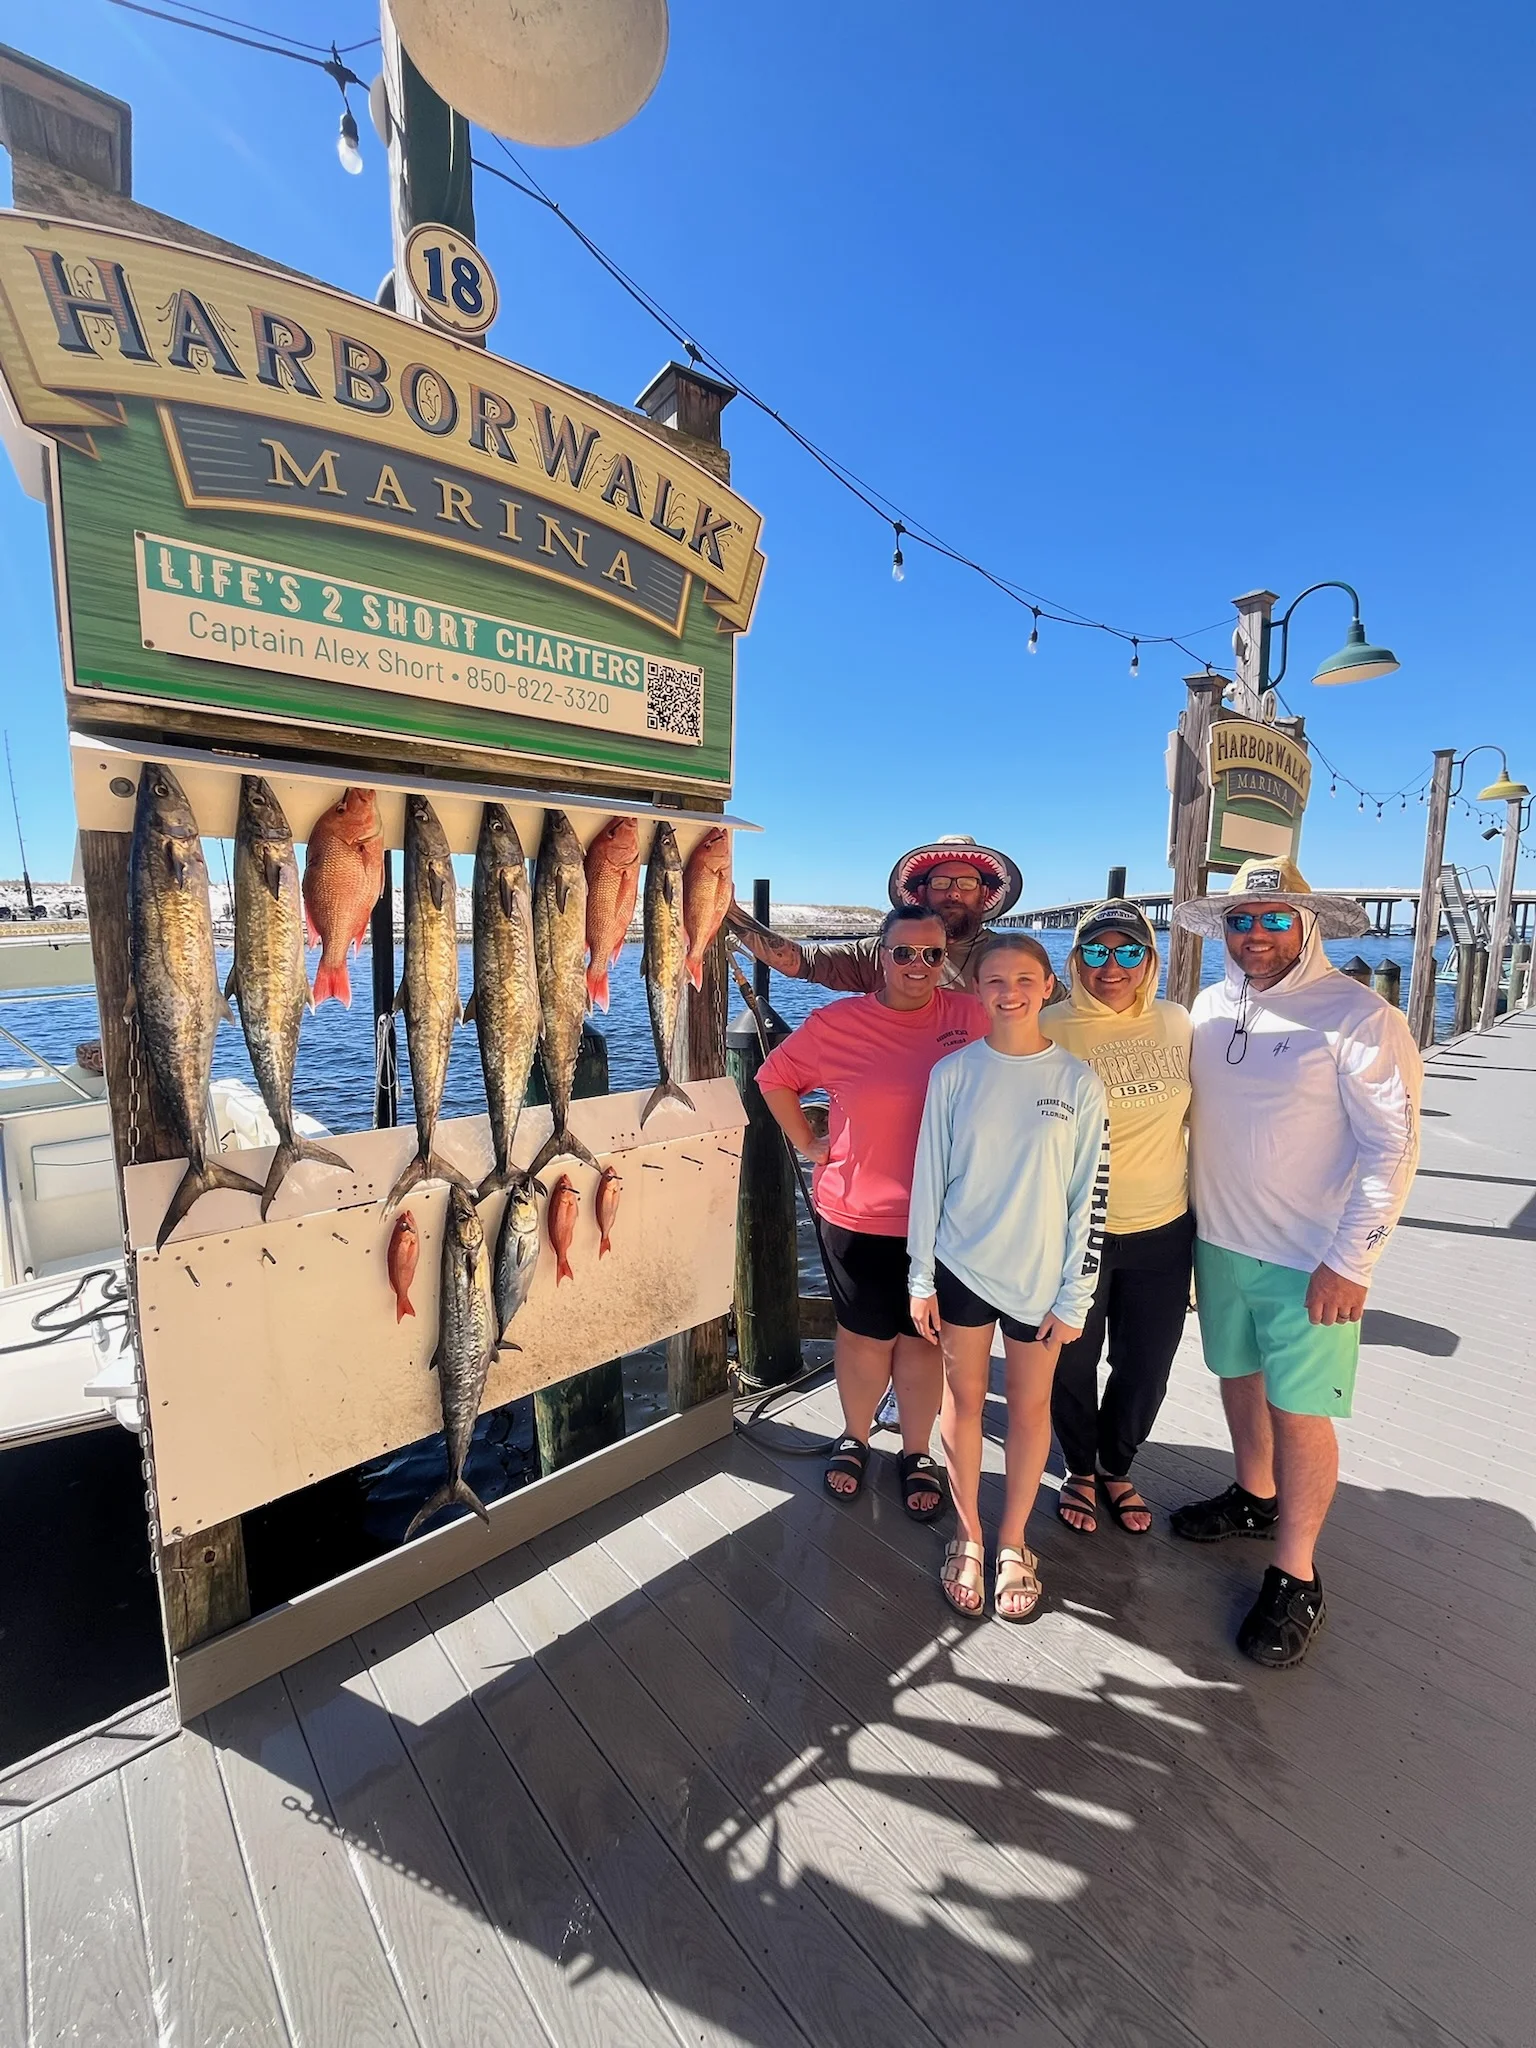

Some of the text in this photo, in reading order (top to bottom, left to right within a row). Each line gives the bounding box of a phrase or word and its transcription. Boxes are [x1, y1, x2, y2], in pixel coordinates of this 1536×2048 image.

[423, 247, 483, 314] 18
[23, 245, 732, 573] HARBORWALK
[261, 438, 637, 590] MARINA
[158, 547, 640, 686] LIFE'S 2 SHORT CHARTERS
[189, 611, 304, 657] Captain
[314, 636, 369, 669] Alex
[378, 648, 445, 683] Short
[467, 666, 609, 714] 850-822-3320
[1266, 696, 1275, 717] 17
[1217, 730, 1307, 789] HARBORWALK
[1237, 773, 1288, 803] MARINA
[1091, 1039, 1157, 1055] ESTABLISHED
[1113, 1047, 1138, 1055] SINCE
[1083, 1053, 1143, 1087] ARRE
[1108, 1086, 1180, 1109] LORIDA
[1120, 1082, 1159, 1097] 1925
[1041, 1109, 1068, 1121] FLORIDA
